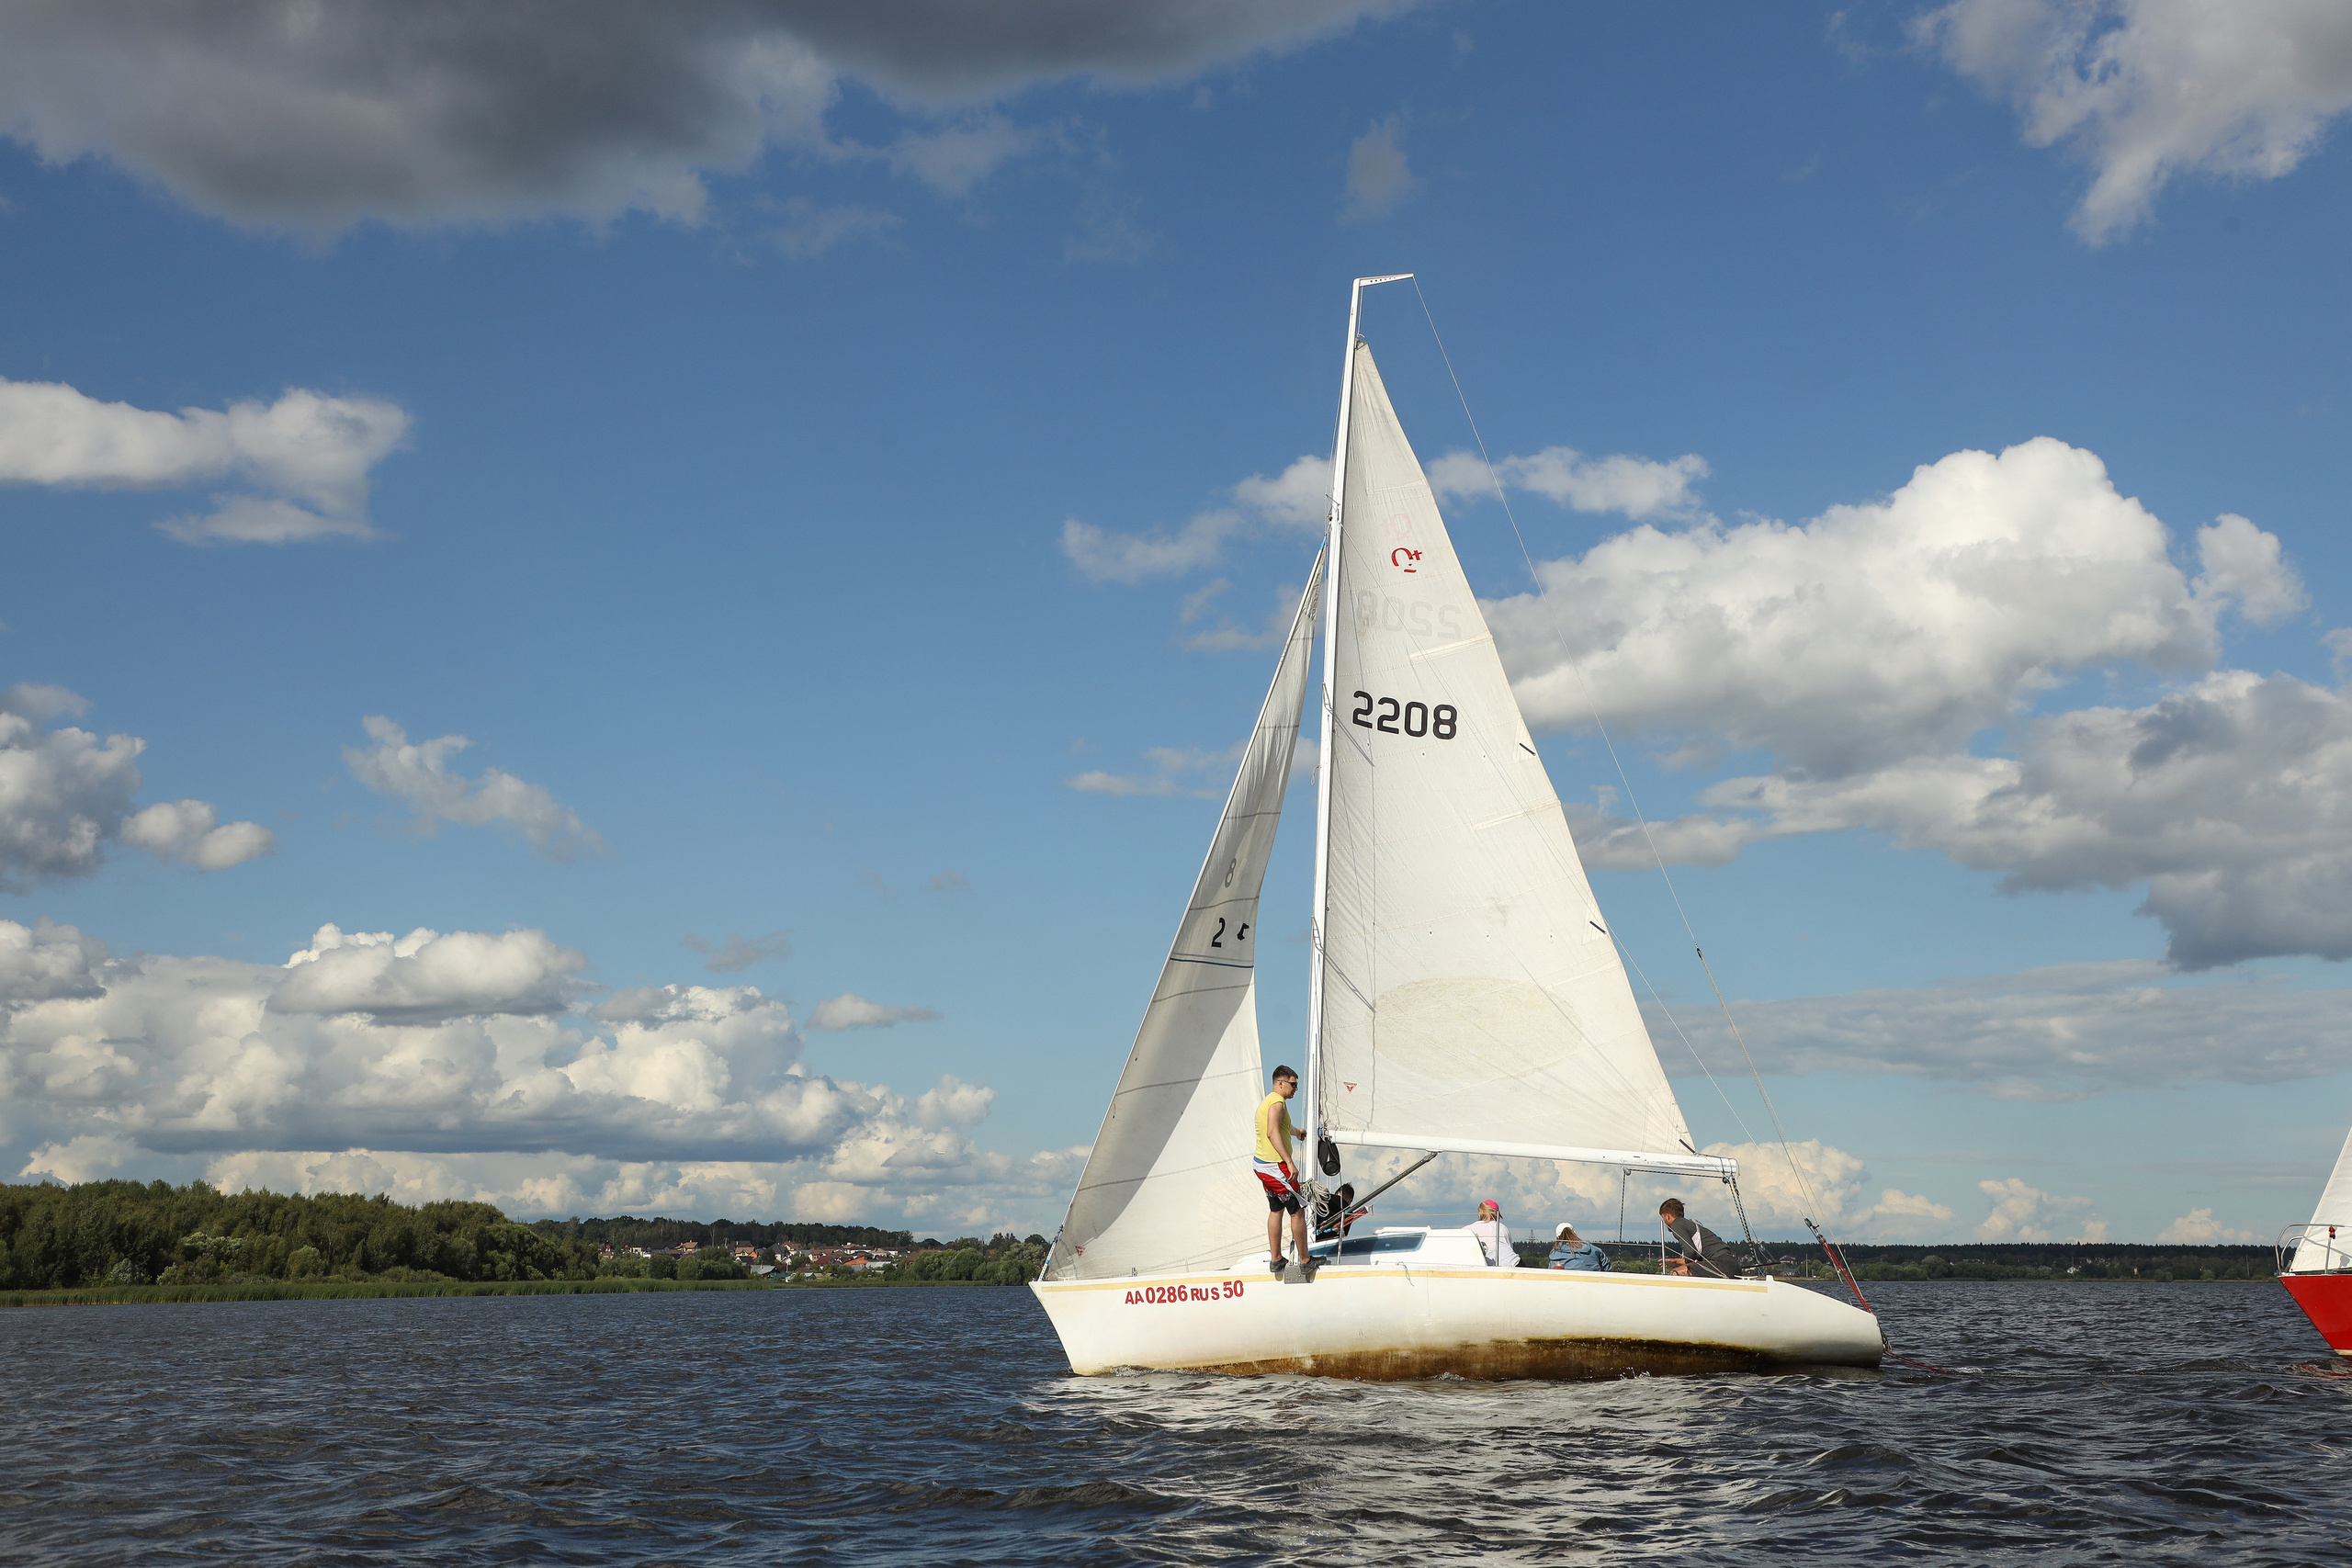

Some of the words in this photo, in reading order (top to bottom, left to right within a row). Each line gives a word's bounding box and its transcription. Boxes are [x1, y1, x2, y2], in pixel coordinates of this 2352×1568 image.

[1352, 690, 1457, 740] 2208
[1191, 1287, 1220, 1301] RUS
[1223, 1280, 1244, 1299] 50
